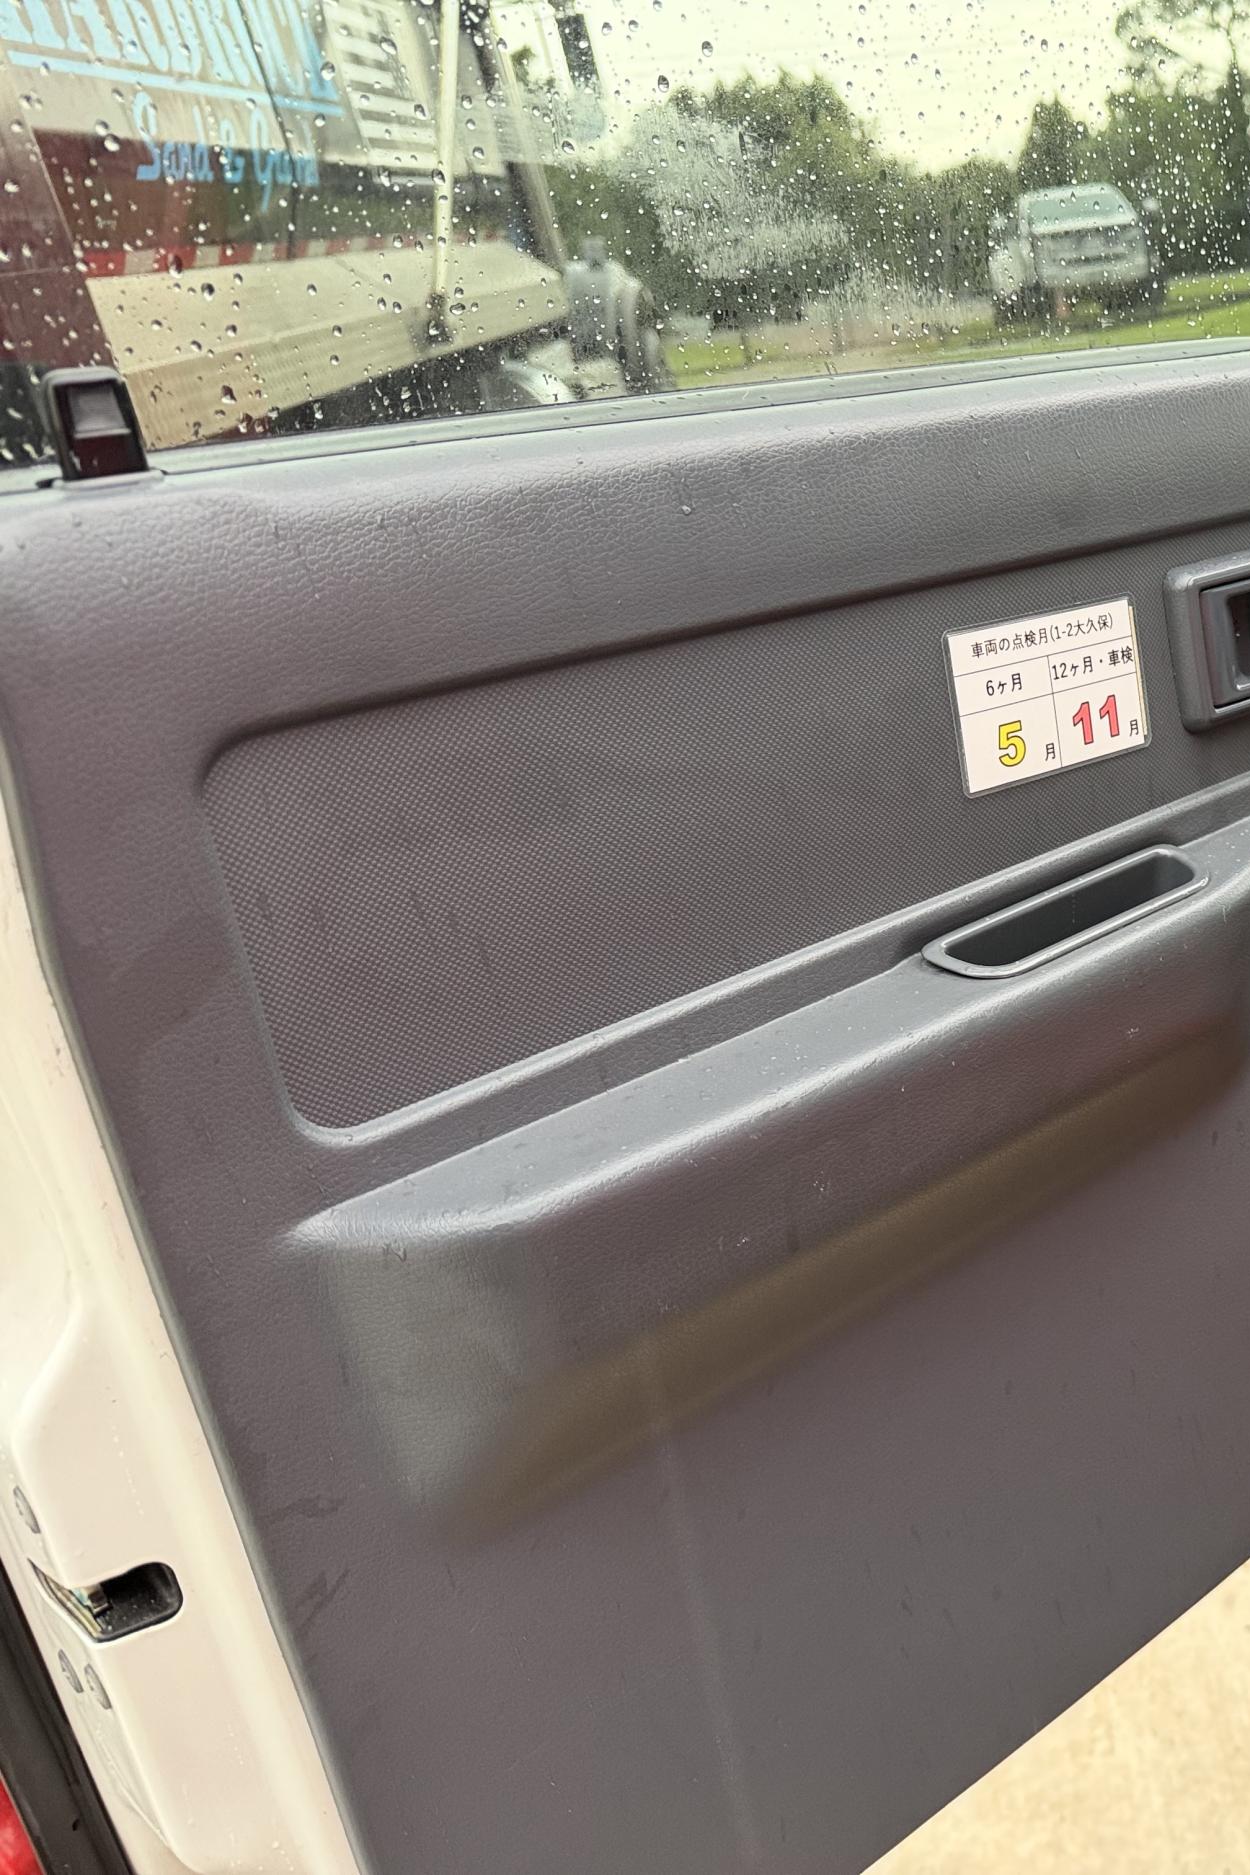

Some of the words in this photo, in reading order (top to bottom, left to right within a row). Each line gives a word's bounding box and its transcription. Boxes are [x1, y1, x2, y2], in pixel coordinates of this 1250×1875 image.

[998, 719, 1027, 768] 5
[1044, 742, 1057, 762] 月
[1072, 694, 1120, 745] 11
[1129, 719, 1140, 737] 月
